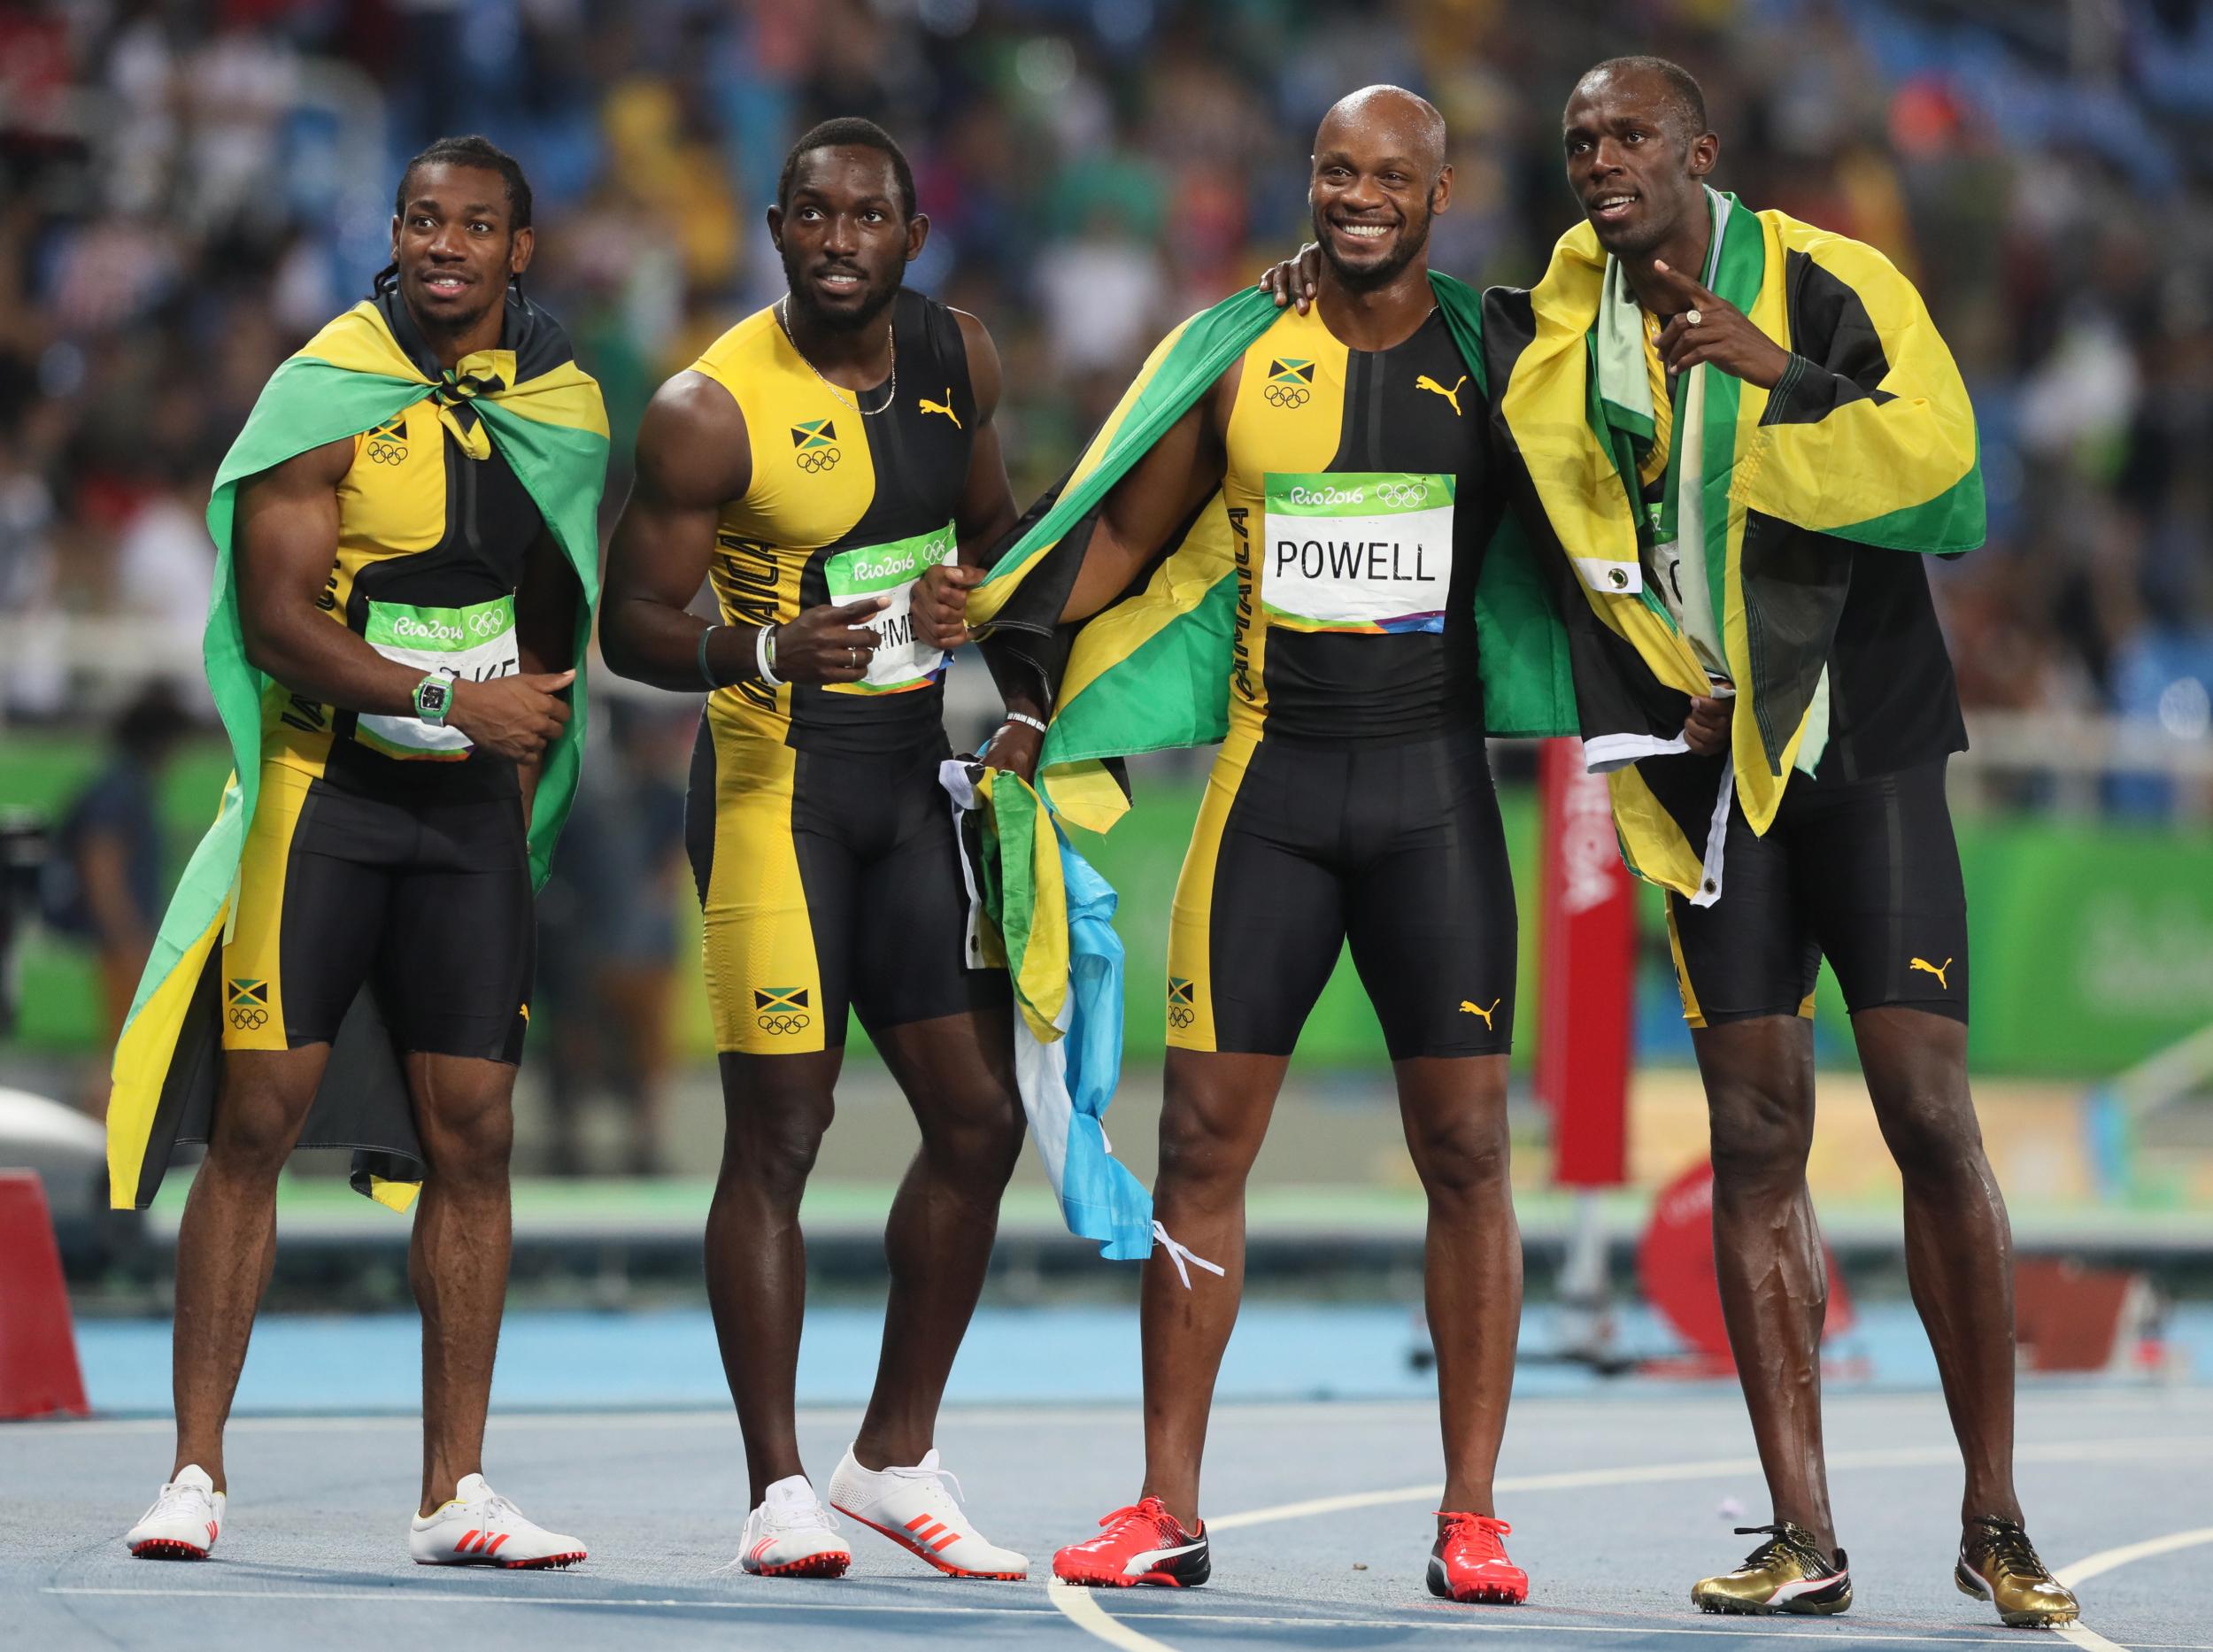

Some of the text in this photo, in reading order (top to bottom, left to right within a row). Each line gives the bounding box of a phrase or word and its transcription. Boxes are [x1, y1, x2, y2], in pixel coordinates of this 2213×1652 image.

[1291, 486, 1364, 506] Rio2016
[854, 552, 915, 582] Rio2016
[1276, 540, 1436, 582] POWELL
